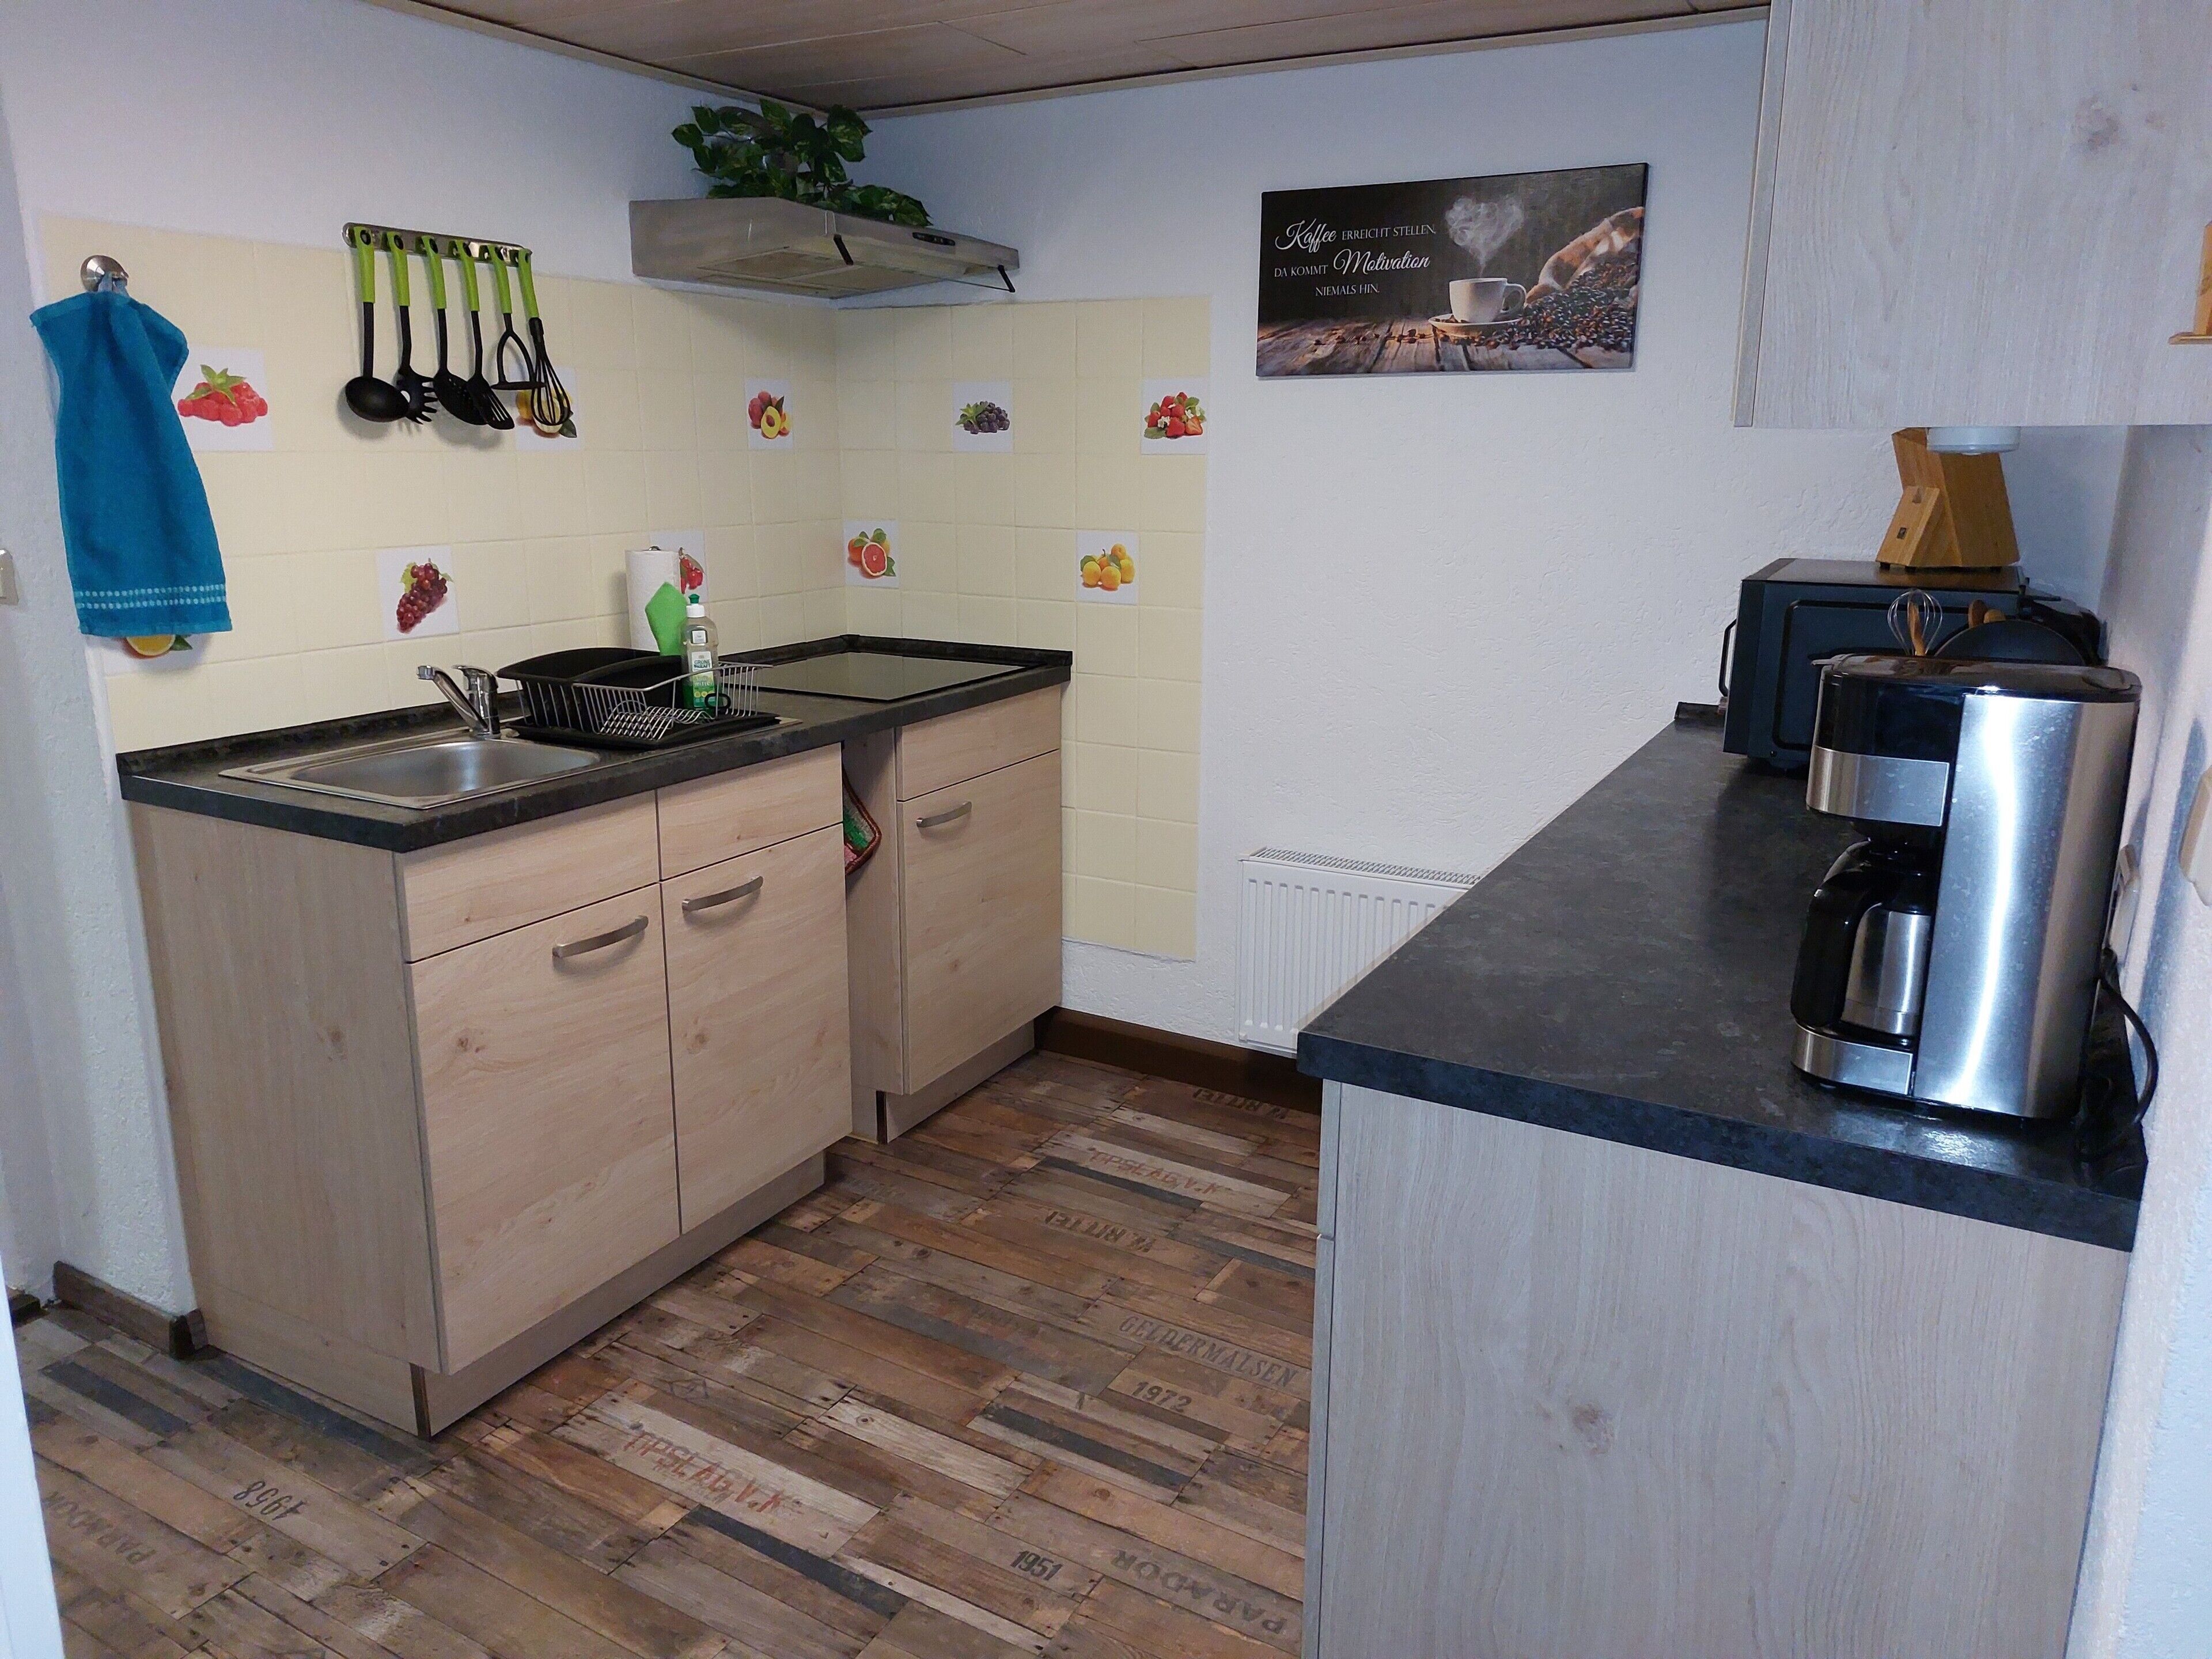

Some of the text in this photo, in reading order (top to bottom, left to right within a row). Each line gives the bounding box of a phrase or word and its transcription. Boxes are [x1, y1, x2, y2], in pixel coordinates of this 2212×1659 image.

[1275, 218, 1336, 253] Kaffee
[1342, 227, 1391, 241] ERREICHT
[1274, 248, 1430, 278] DA KOMMT Motivation
[1315, 285, 1357, 297] NIEMALS
[1119, 1315, 1298, 1387] GELDERMALSEN
[1131, 1381, 1194, 1413] 1972
[1010, 1549, 1063, 1581] 1951
[1111, 1549, 1288, 1635] PARADOR
